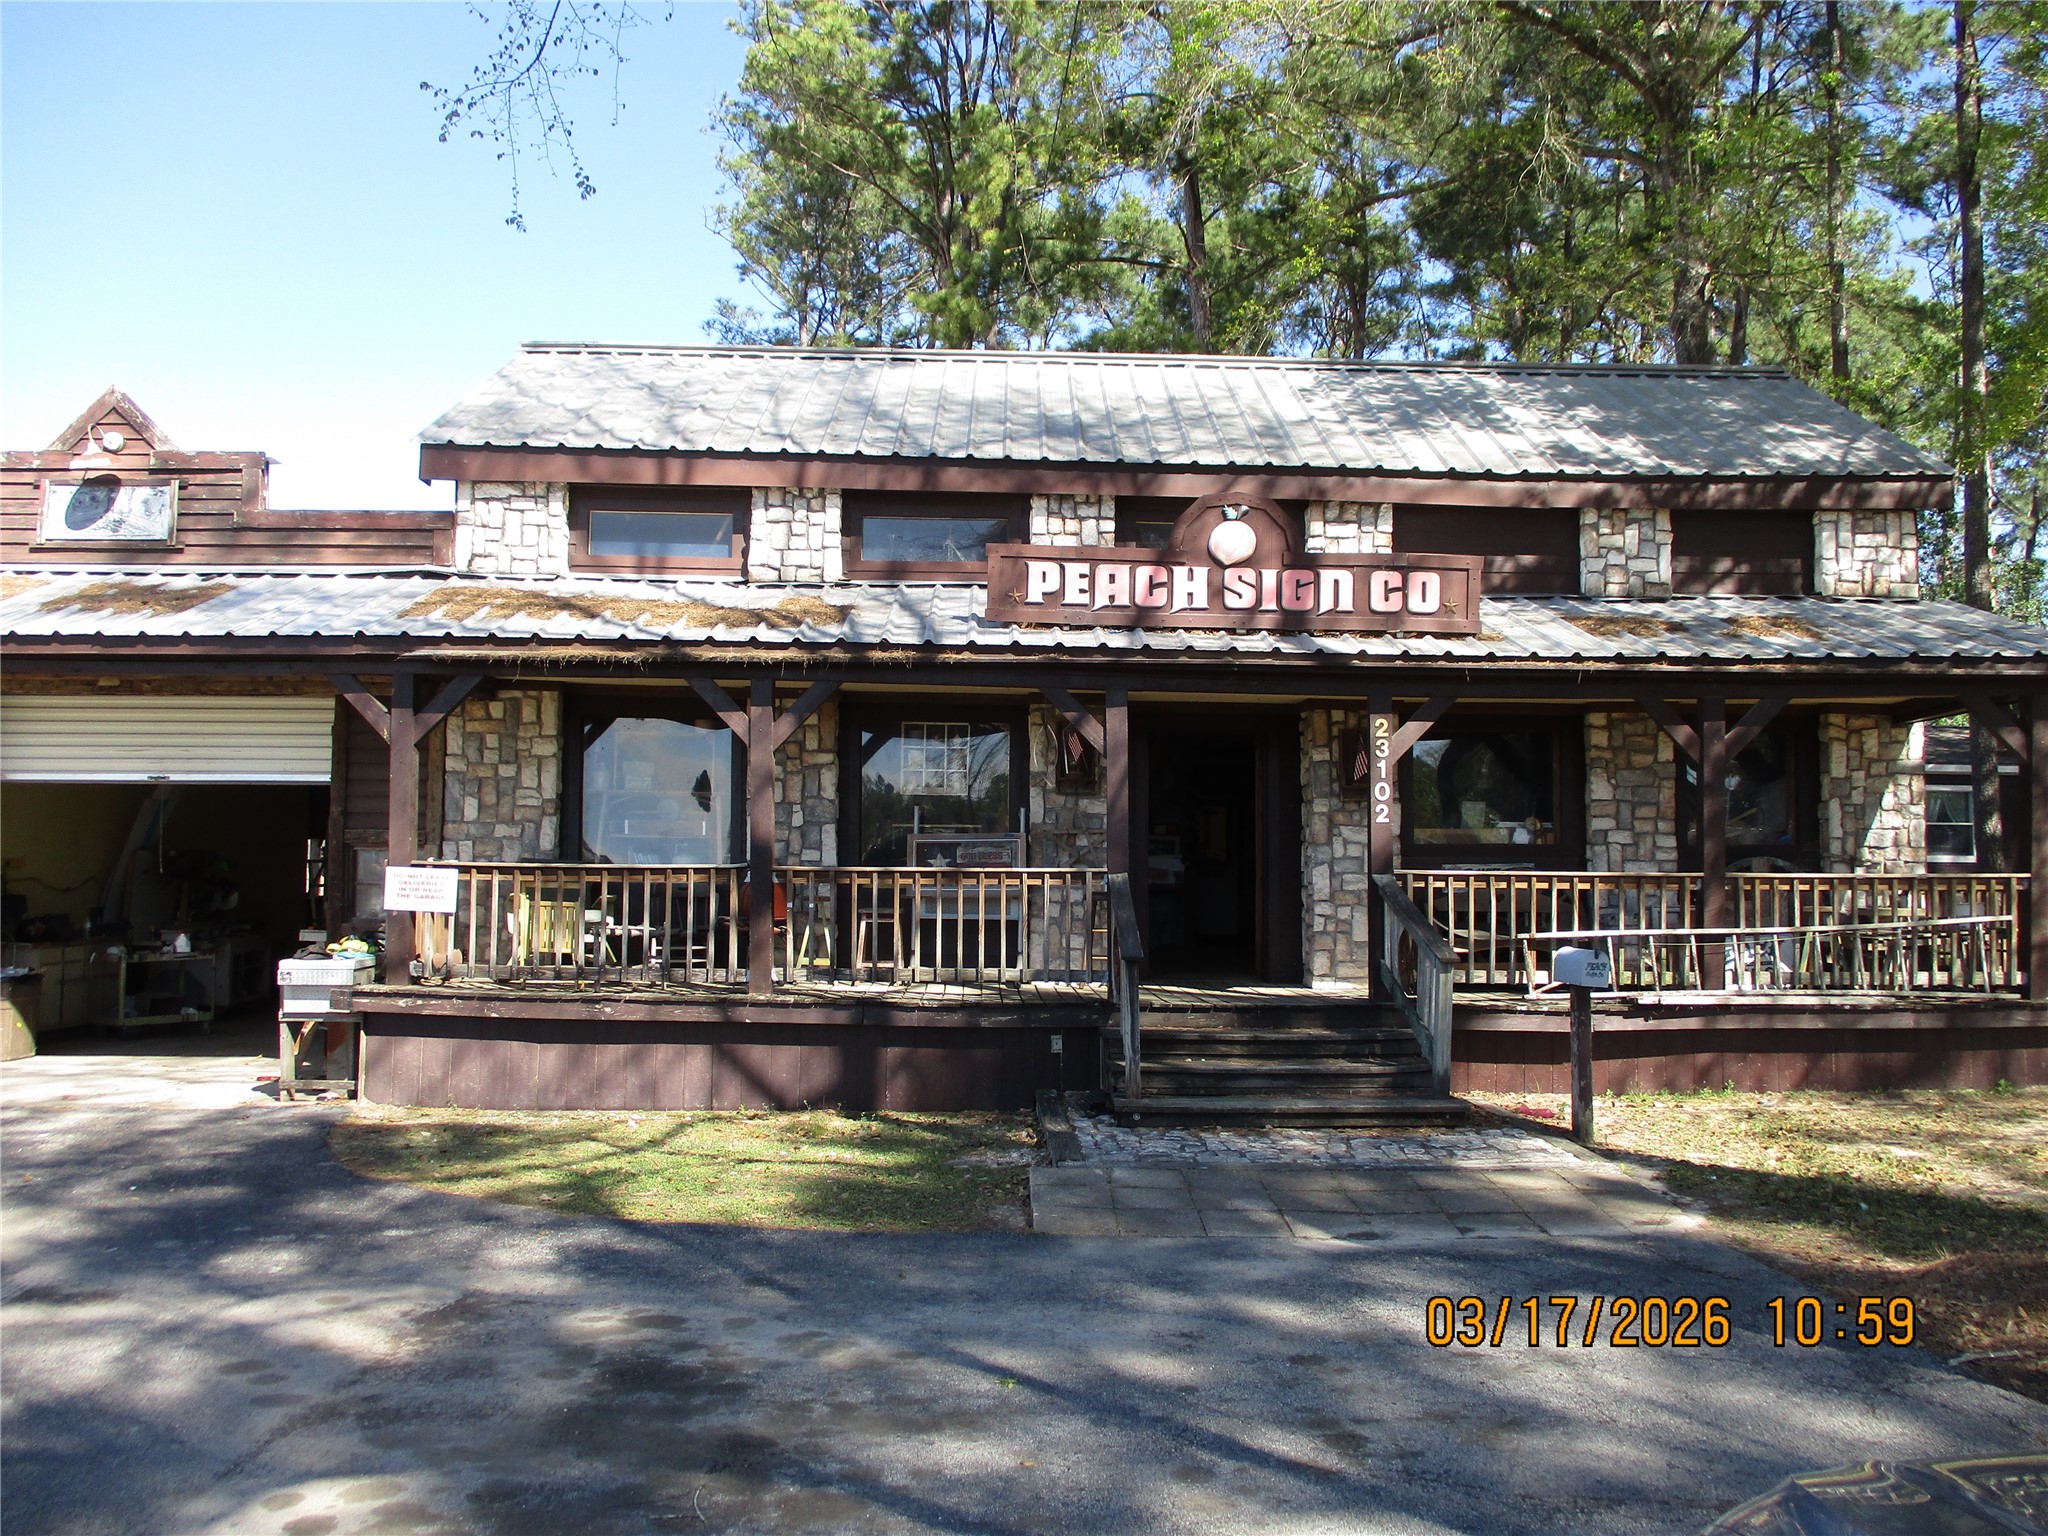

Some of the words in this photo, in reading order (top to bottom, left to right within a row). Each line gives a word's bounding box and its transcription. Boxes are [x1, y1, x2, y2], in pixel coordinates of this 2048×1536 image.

[1024, 560, 1211, 614] PEACH
[1222, 567, 1356, 617] SIGN
[1369, 570, 1441, 615] CO
[1374, 718, 1391, 823] 23102
